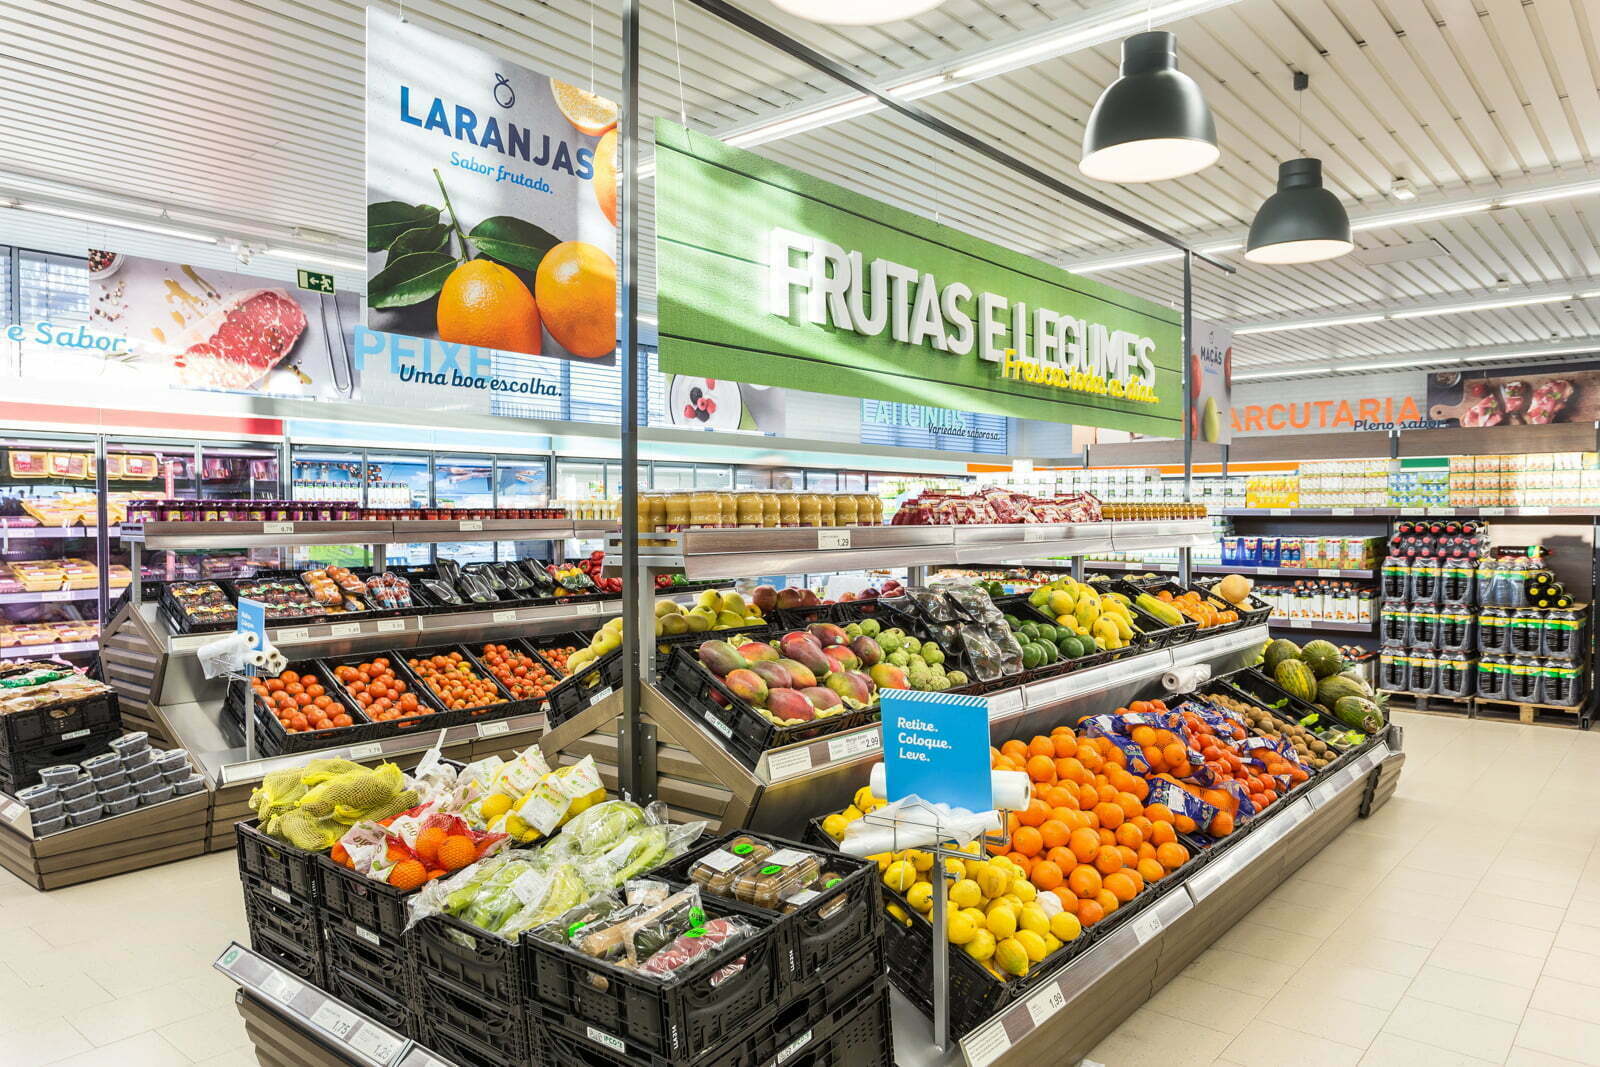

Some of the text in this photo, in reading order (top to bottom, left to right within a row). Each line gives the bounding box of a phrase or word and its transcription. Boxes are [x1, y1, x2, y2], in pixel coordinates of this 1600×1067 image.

[401, 85, 594, 180] LARANJAS
[450, 151, 554, 194] Sabor frutado.
[768, 227, 1157, 388] FRUTAS E LEGUMES
[7, 321, 133, 352] e Sabor.
[353, 325, 491, 382] PEIXE
[399, 363, 563, 397] Uma boa escolha.
[928, 423, 1001, 441] Variedade saborosa.
[1354, 419, 1395, 431] Pleno
[897, 716, 939, 733] Retire.
[898, 732, 952, 750] Coloque.
[899, 747, 931, 762] Leve.
[1049, 992, 1063, 1009] 1,99
